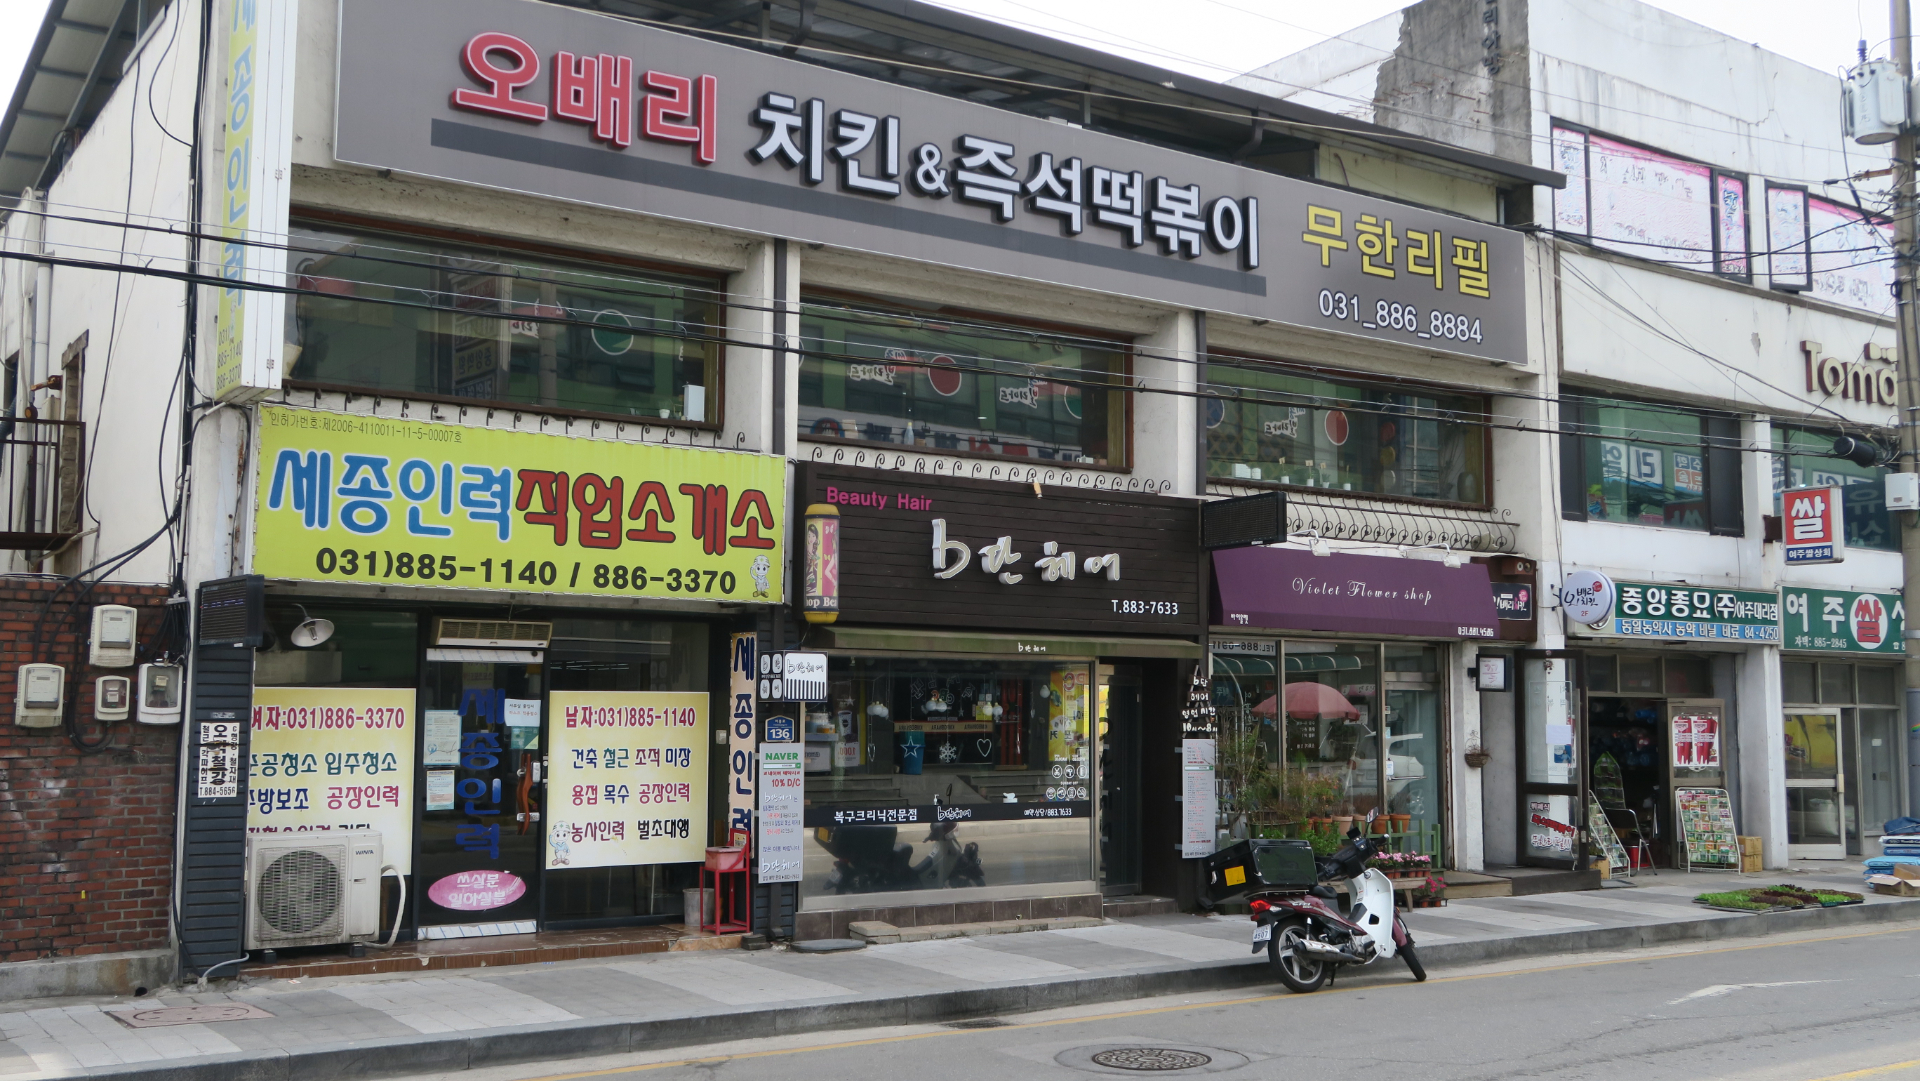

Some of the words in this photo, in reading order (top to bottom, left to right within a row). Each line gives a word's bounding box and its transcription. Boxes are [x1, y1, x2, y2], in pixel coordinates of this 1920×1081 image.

[452, 31, 719, 165] 오배리
[1303, 203, 1491, 298] 무한리필
[1319, 288, 1483, 344] 031_886_8884
[267, 448, 513, 541] 세종인력
[515, 469, 776, 555] 직업소개소
[826, 487, 887, 510] Beauty
[897, 493, 932, 511] Hair
[1791, 495, 1826, 540] 쌀
[1789, 548, 1831, 558] 여주쌀상회
[315, 547, 557, 586] 031)885-1140
[593, 563, 736, 595] 886-3370
[1292, 577, 1340, 596] Violet
[1347, 579, 1398, 599] Flower
[1404, 587, 1432, 606] shop
[1622, 587, 1711, 618] 중앙종묘
[1737, 601, 1778, 620] 여주대리점
[1111, 599, 1180, 615] T.883-7633
[1622, 620, 1672, 636] 동일농약사
[1676, 623, 1696, 637] 농약
[1699, 624, 1717, 638] 비닐
[1722, 625, 1740, 639] 비료
[770, 729, 790, 738] 136
[325, 752, 398, 776] 입주청소
[572, 748, 598, 769] 건축
[603, 748, 630, 768] 철근
[635, 748, 660, 767] 조적
[665, 748, 691, 767] 미장
[765, 752, 799, 760] NAVER
[455, 688, 505, 859] 세종인력
[772, 779, 785, 787] 10%
[787, 778, 801, 787] D/C
[327, 786, 399, 810] 공장인력
[572, 784, 598, 806] 용접
[603, 784, 630, 804] 목수
[638, 783, 690, 804] 공장인력
[834, 808, 918, 824] 복구크리닉전문점
[571, 820, 625, 843] 농사인력
[637, 818, 690, 840] 벌초대행
[457, 873, 499, 889] 쓰실분
